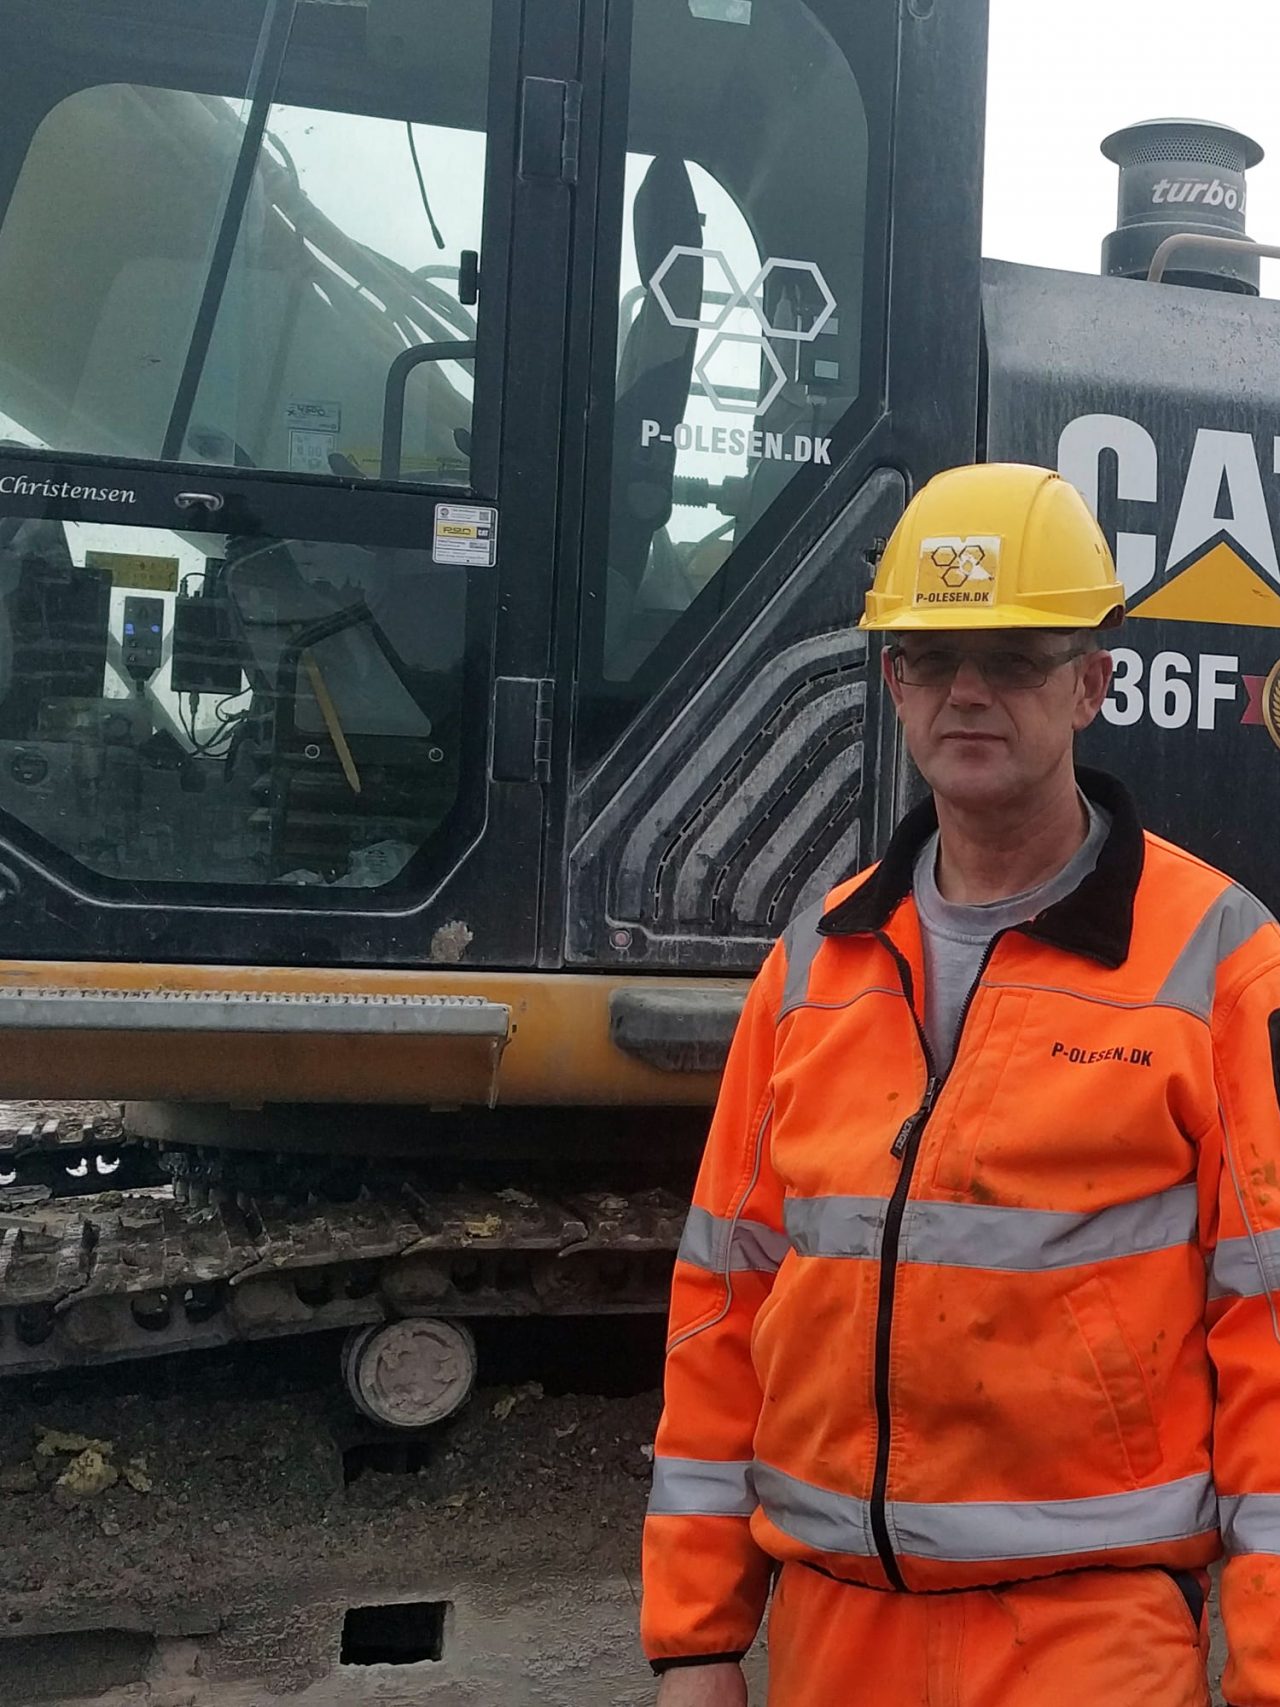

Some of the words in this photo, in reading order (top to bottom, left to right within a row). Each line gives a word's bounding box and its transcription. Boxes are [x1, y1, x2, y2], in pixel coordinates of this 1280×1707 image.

[1152, 179, 1237, 210] turbo
[641, 419, 832, 465] P-OLESEN.DK
[0, 475, 137, 503] Christensen
[916, 592, 989, 603] P-OLESEN.DK
[1051, 1041, 1154, 1067] P-OLESEN.DK
